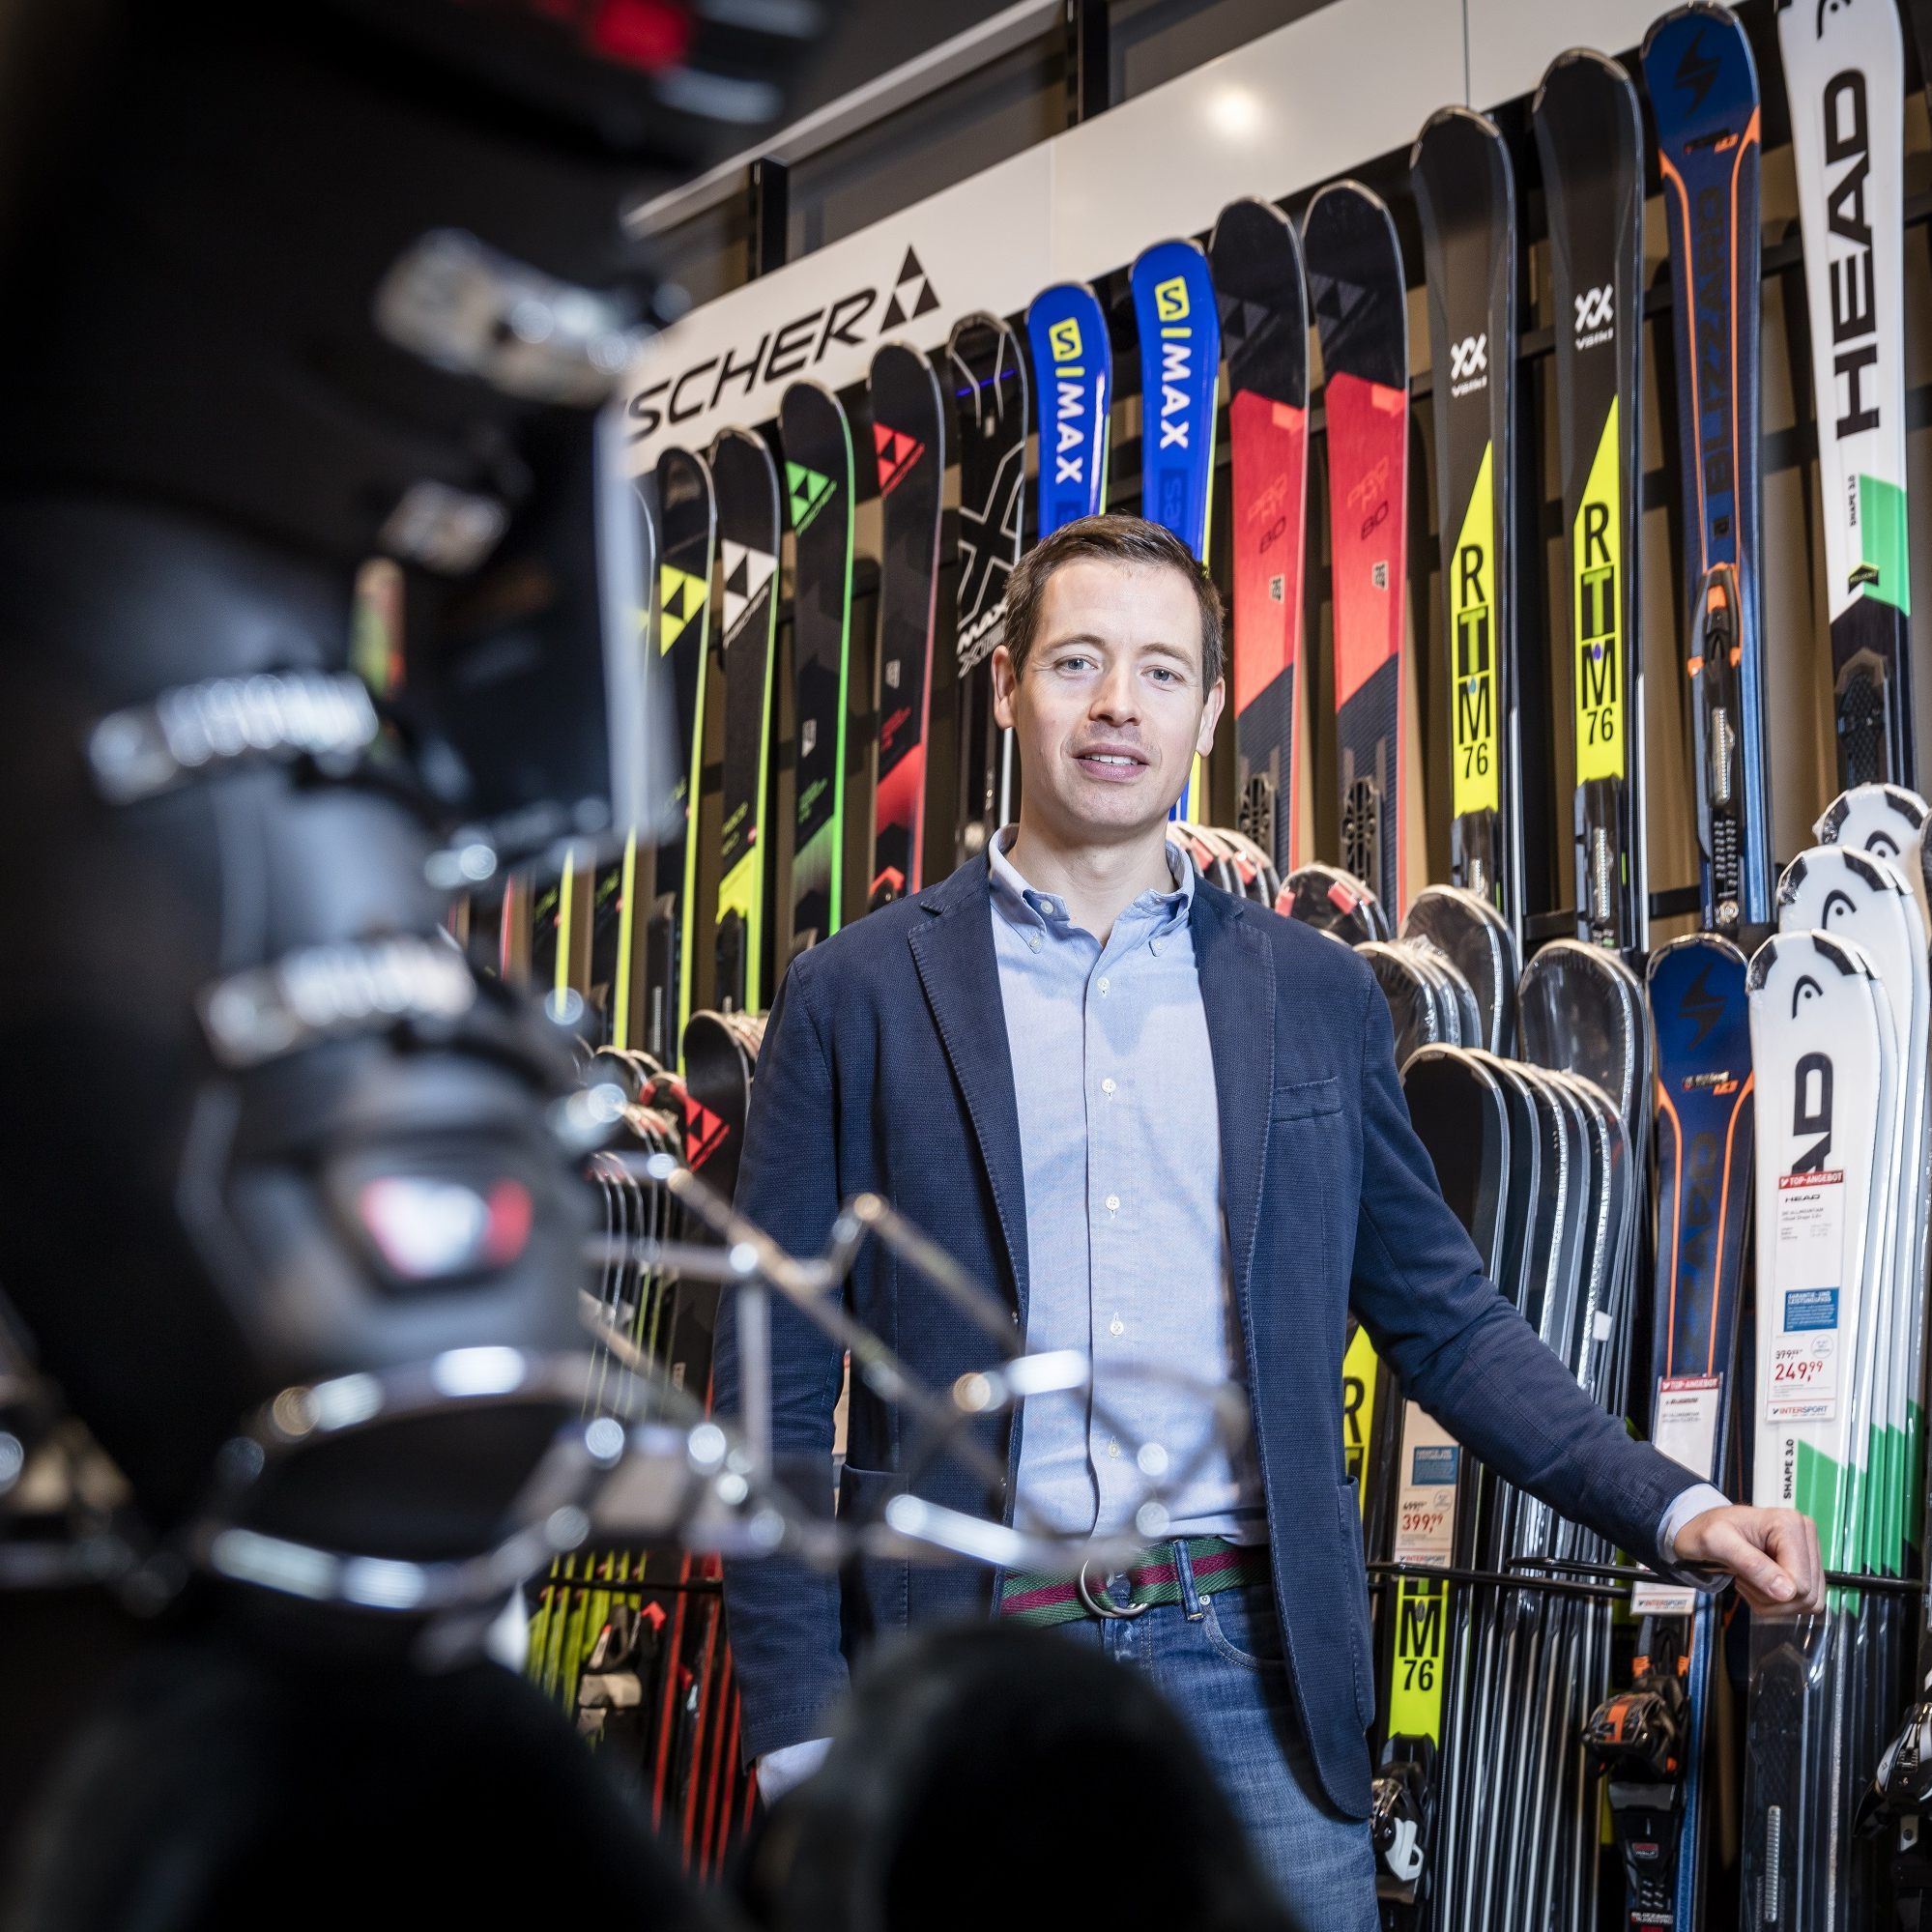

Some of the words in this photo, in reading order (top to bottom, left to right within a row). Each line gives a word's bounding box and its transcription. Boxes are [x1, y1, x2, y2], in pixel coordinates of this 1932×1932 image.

[1823, 69, 1880, 441] HEAD
[627, 287, 877, 445] SCHER
[1848, 494, 1857, 527] SHAPE
[1587, 707, 1614, 745] 76
[1463, 743, 1489, 779] 76
[1789, 1170, 1843, 1187] TOP-ANGEBOT
[1774, 1361, 1824, 1382] 249,99
[1779, 1405, 1829, 1414] INTERSPORT
[1785, 1438, 1795, 1456] 3.0
[1783, 1459, 1793, 1499] SHAPE
[1401, 1514, 1444, 1535] 399,99
[1403, 1659, 1434, 1691] 76
